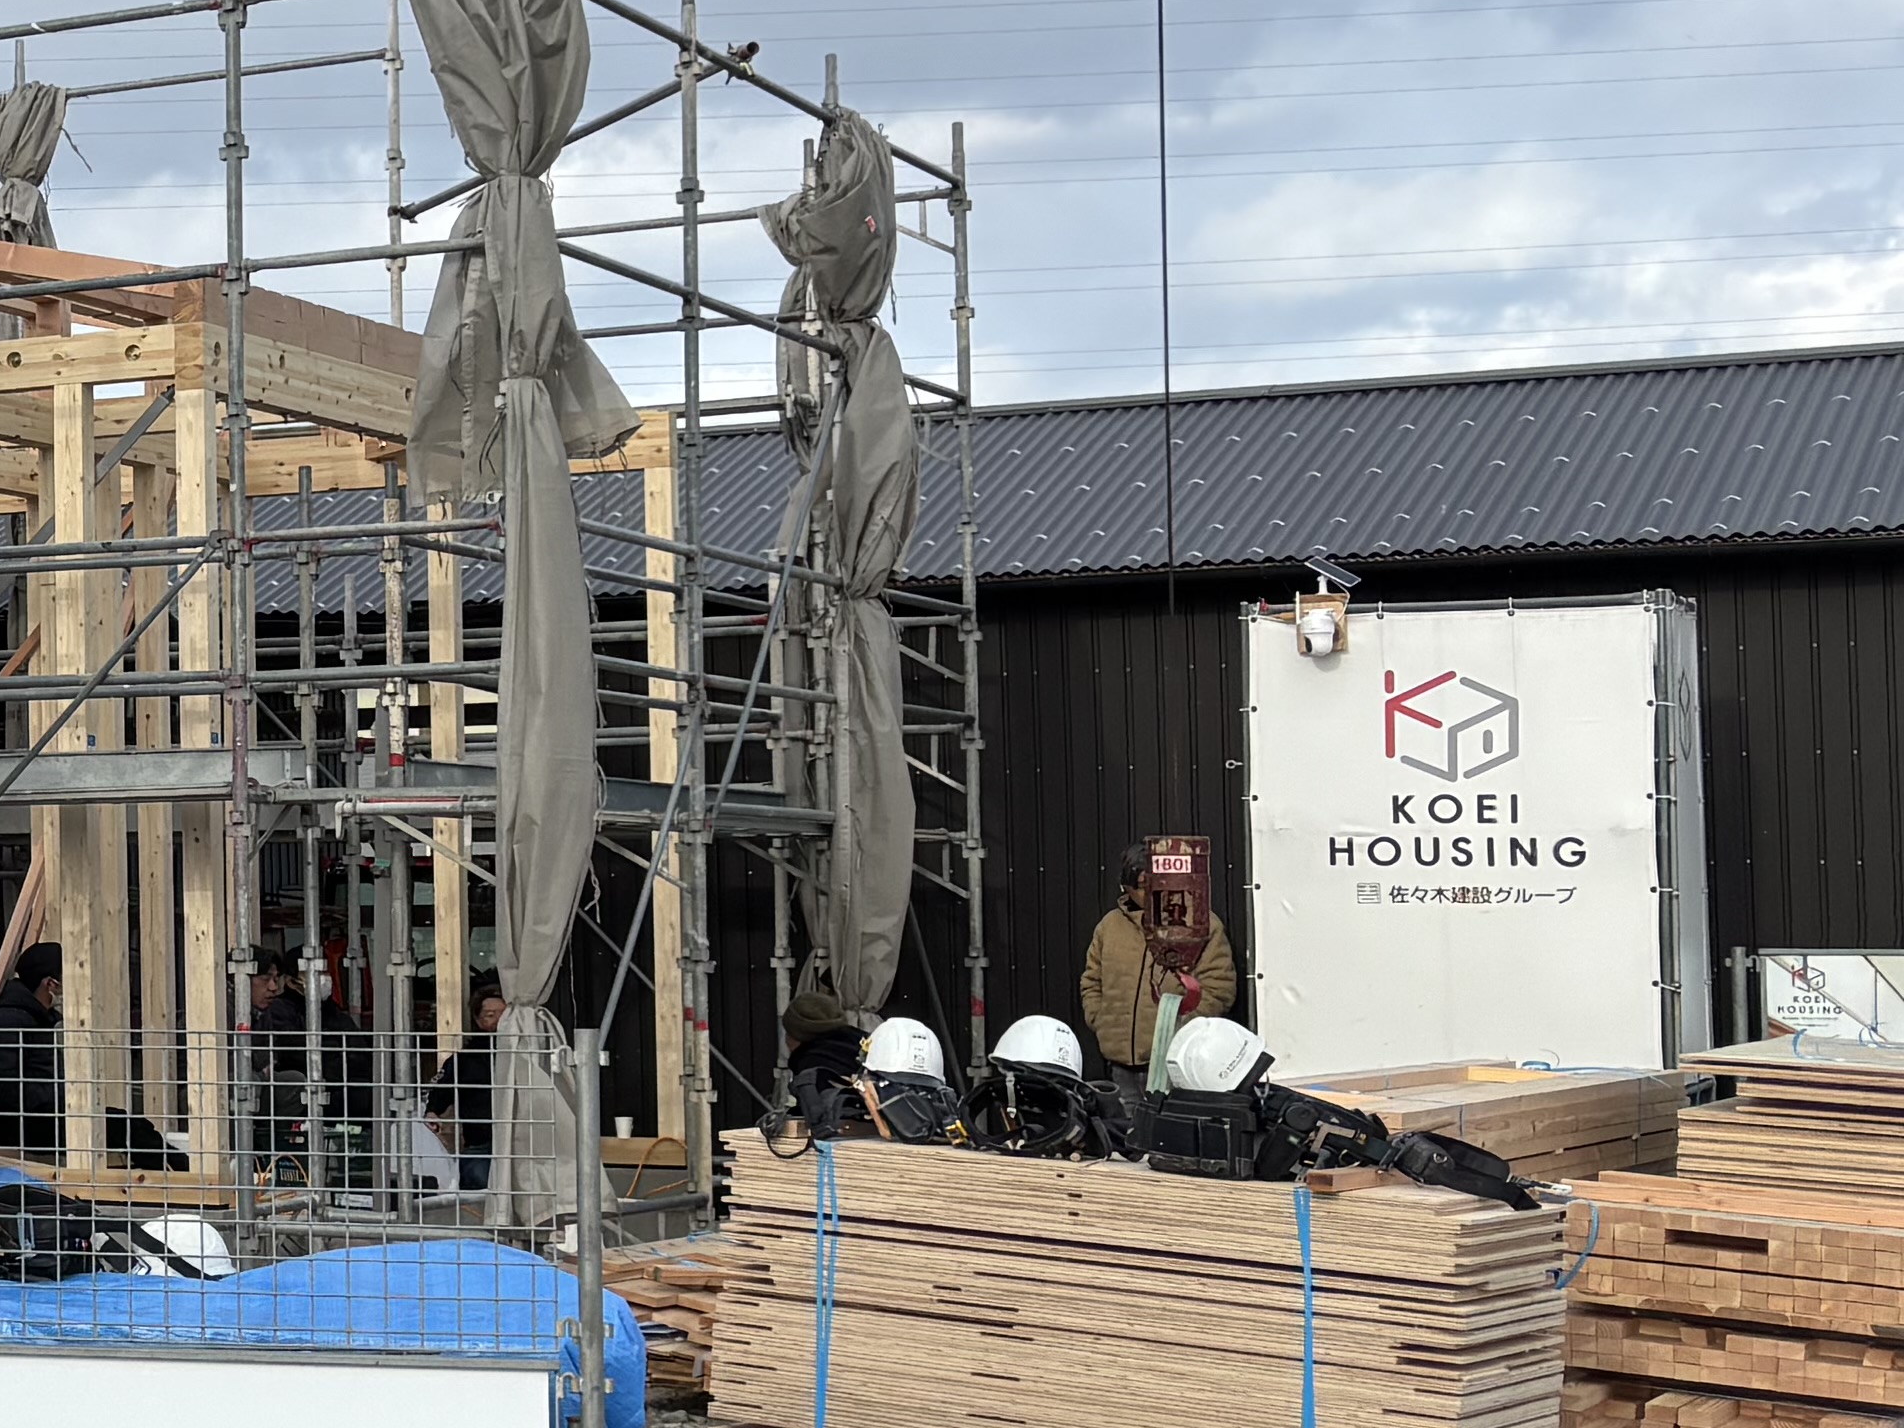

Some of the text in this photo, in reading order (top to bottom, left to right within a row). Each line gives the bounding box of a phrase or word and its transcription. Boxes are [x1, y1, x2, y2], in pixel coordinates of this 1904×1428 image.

[1392, 793, 1519, 824] KOEI
[1329, 836, 1588, 868] HOUSING
[1388, 885, 1578, 905] 佐々木建設グループ
